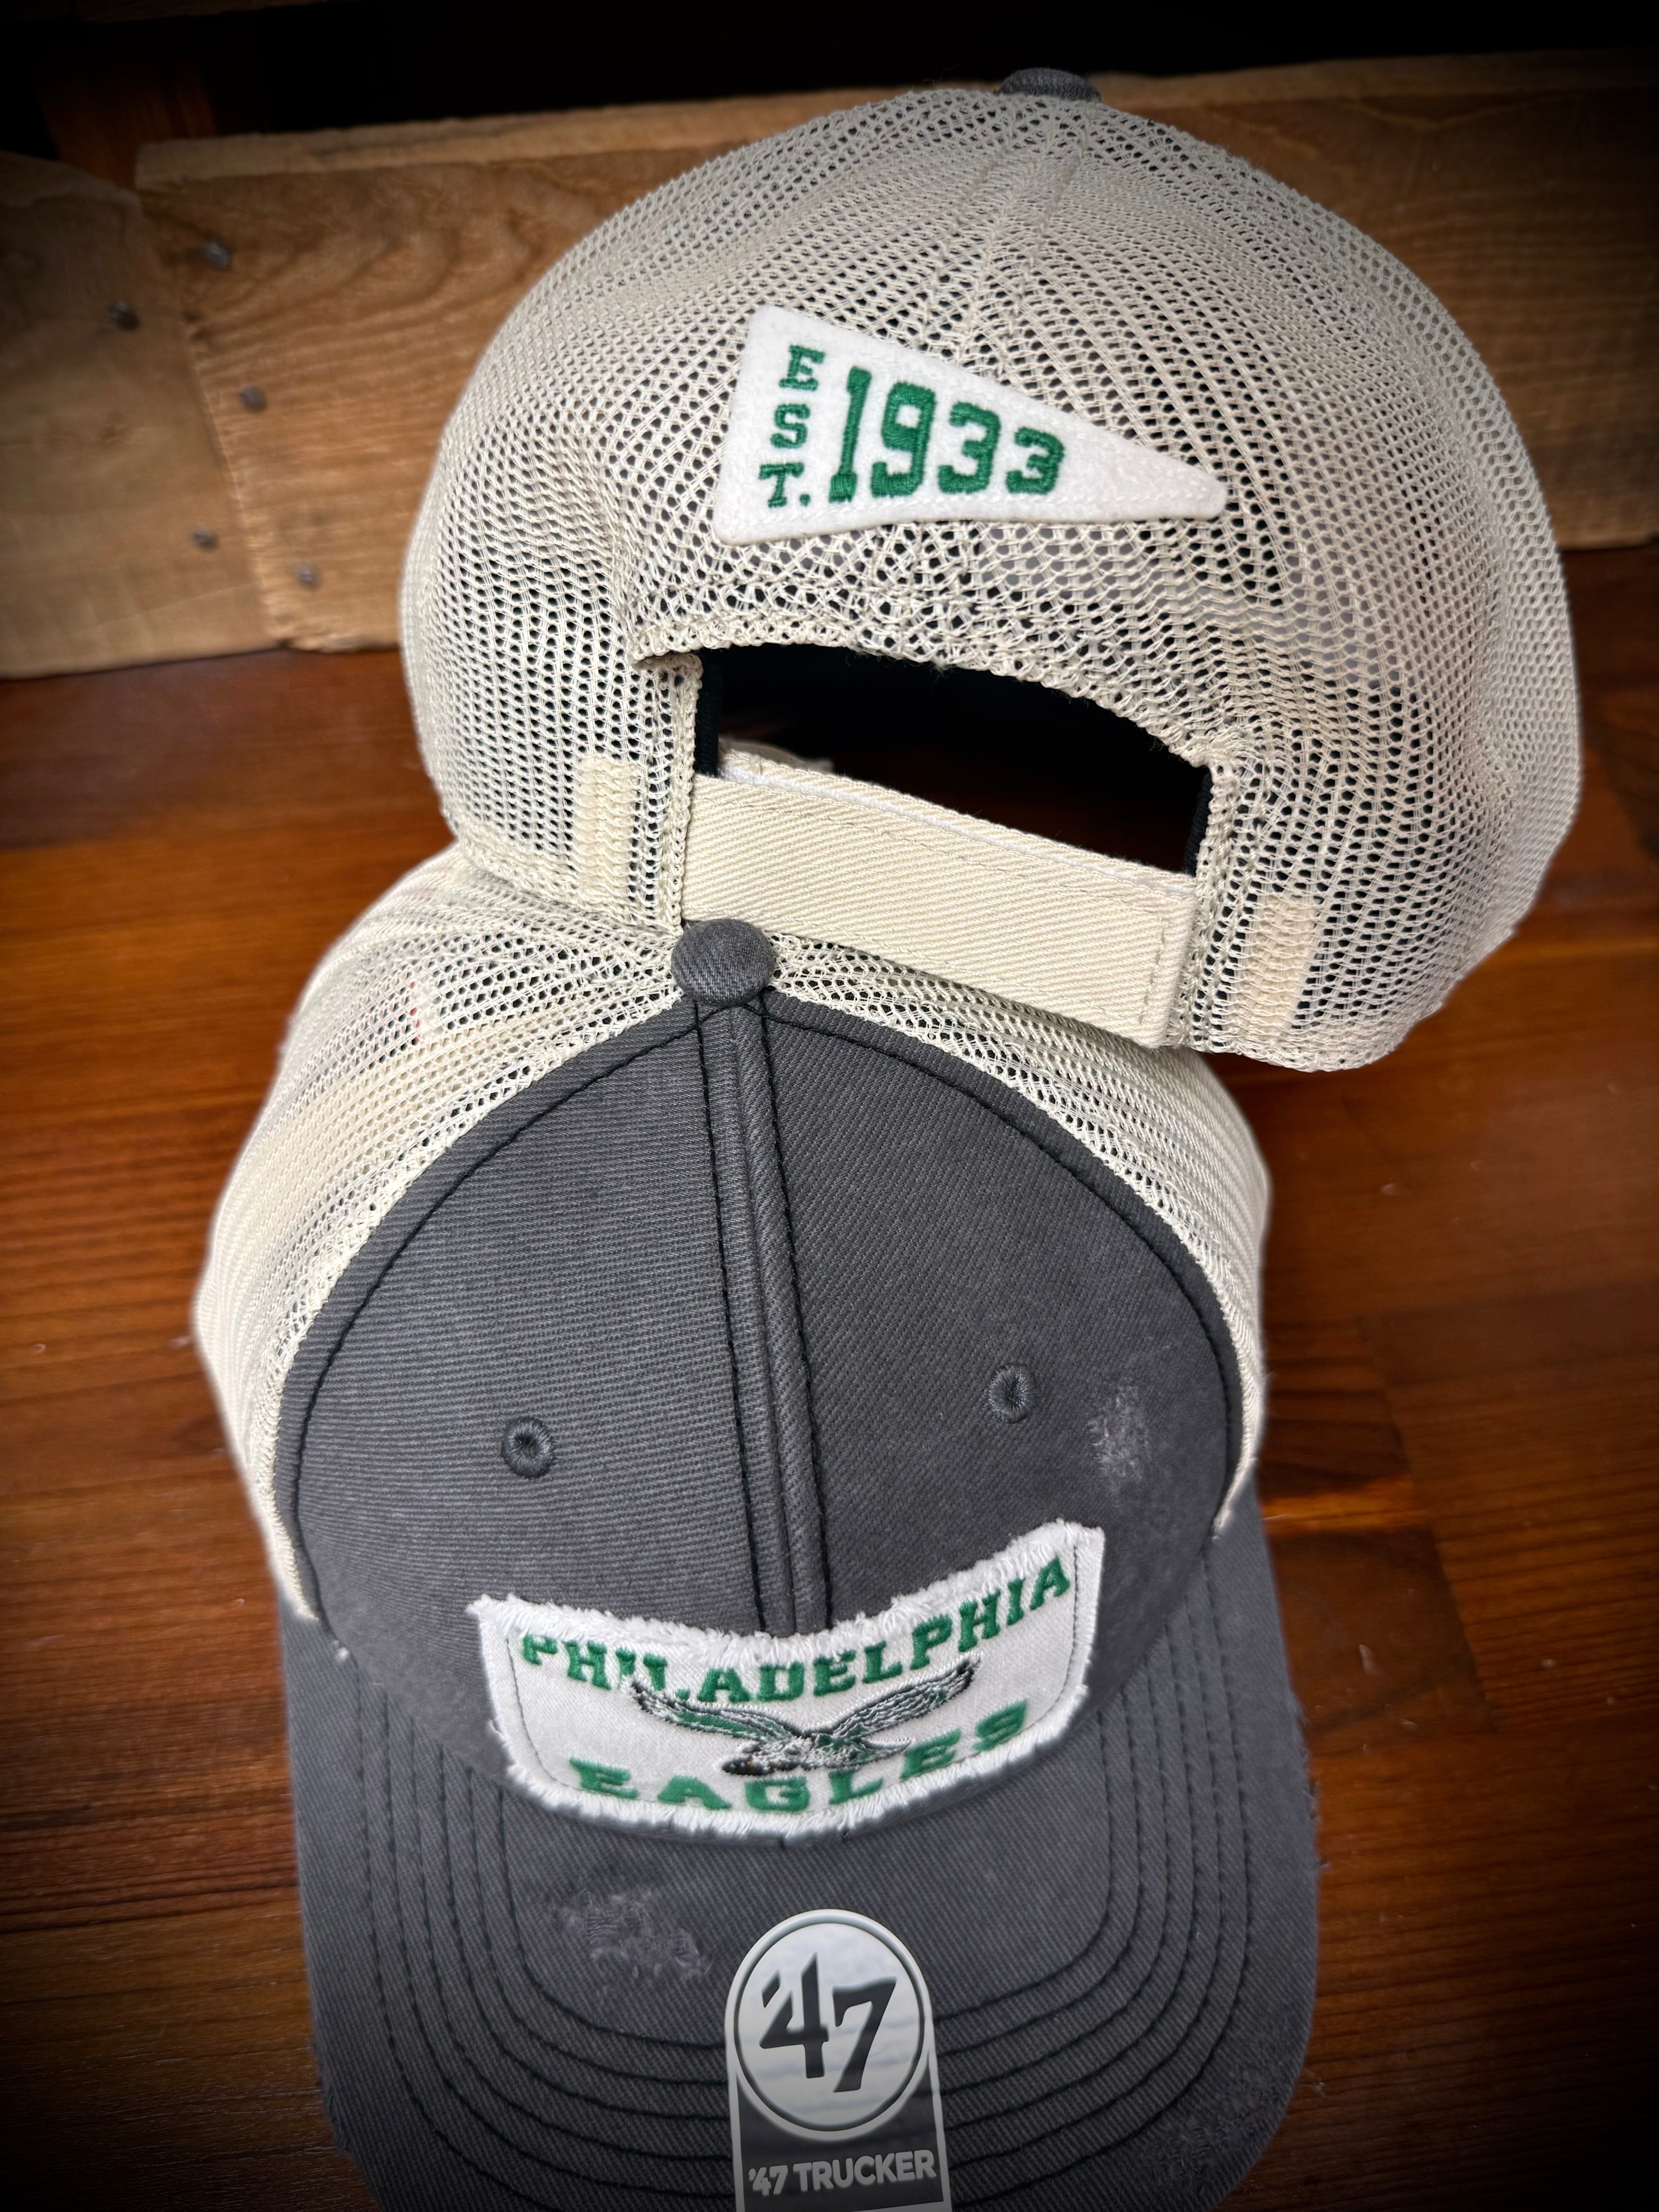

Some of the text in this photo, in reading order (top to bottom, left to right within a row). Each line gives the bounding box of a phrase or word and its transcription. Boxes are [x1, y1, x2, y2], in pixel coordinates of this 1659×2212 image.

[758, 344, 825, 508] EST.
[829, 366, 1065, 503] 1933
[522, 1556, 1071, 1703] PHILADELPHIA
[568, 1699, 1027, 1813] EAGLES
[759, 1952, 897, 2093] '47
[748, 2149, 937, 2196] '47 TRUCKER
